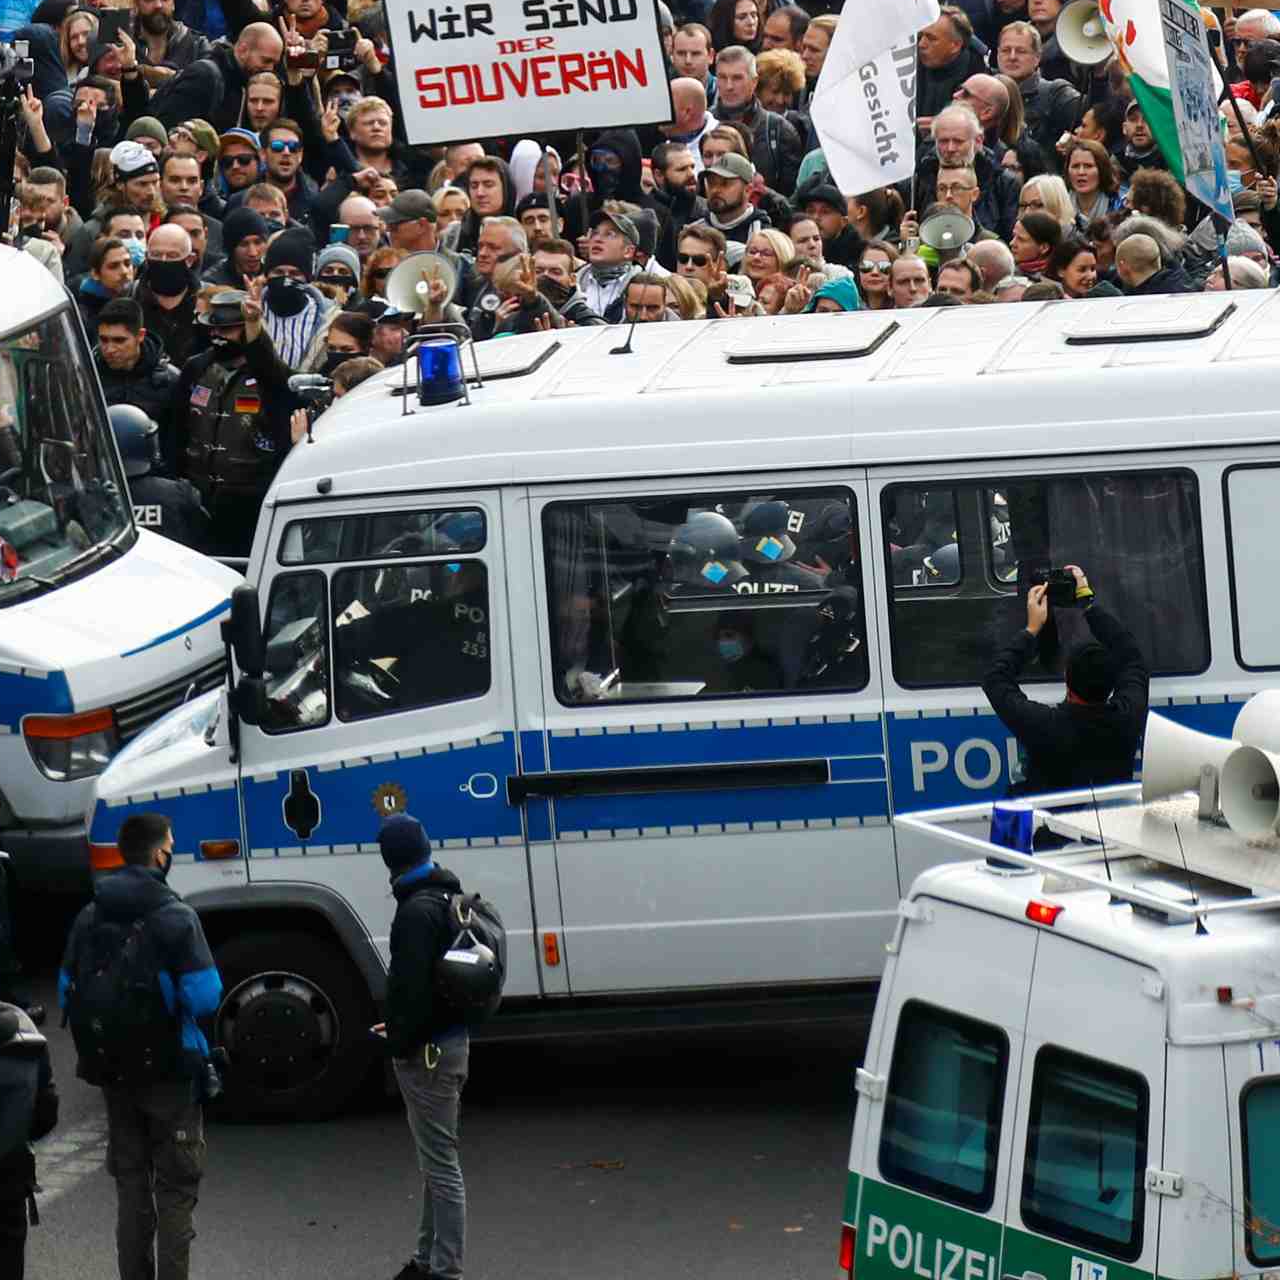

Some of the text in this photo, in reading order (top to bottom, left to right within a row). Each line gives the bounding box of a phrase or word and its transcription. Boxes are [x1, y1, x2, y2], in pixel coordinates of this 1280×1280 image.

[496, 35, 555, 56] DER
[415, 47, 648, 109] SOUVERÄN
[858, 61, 900, 167] Gesicht
